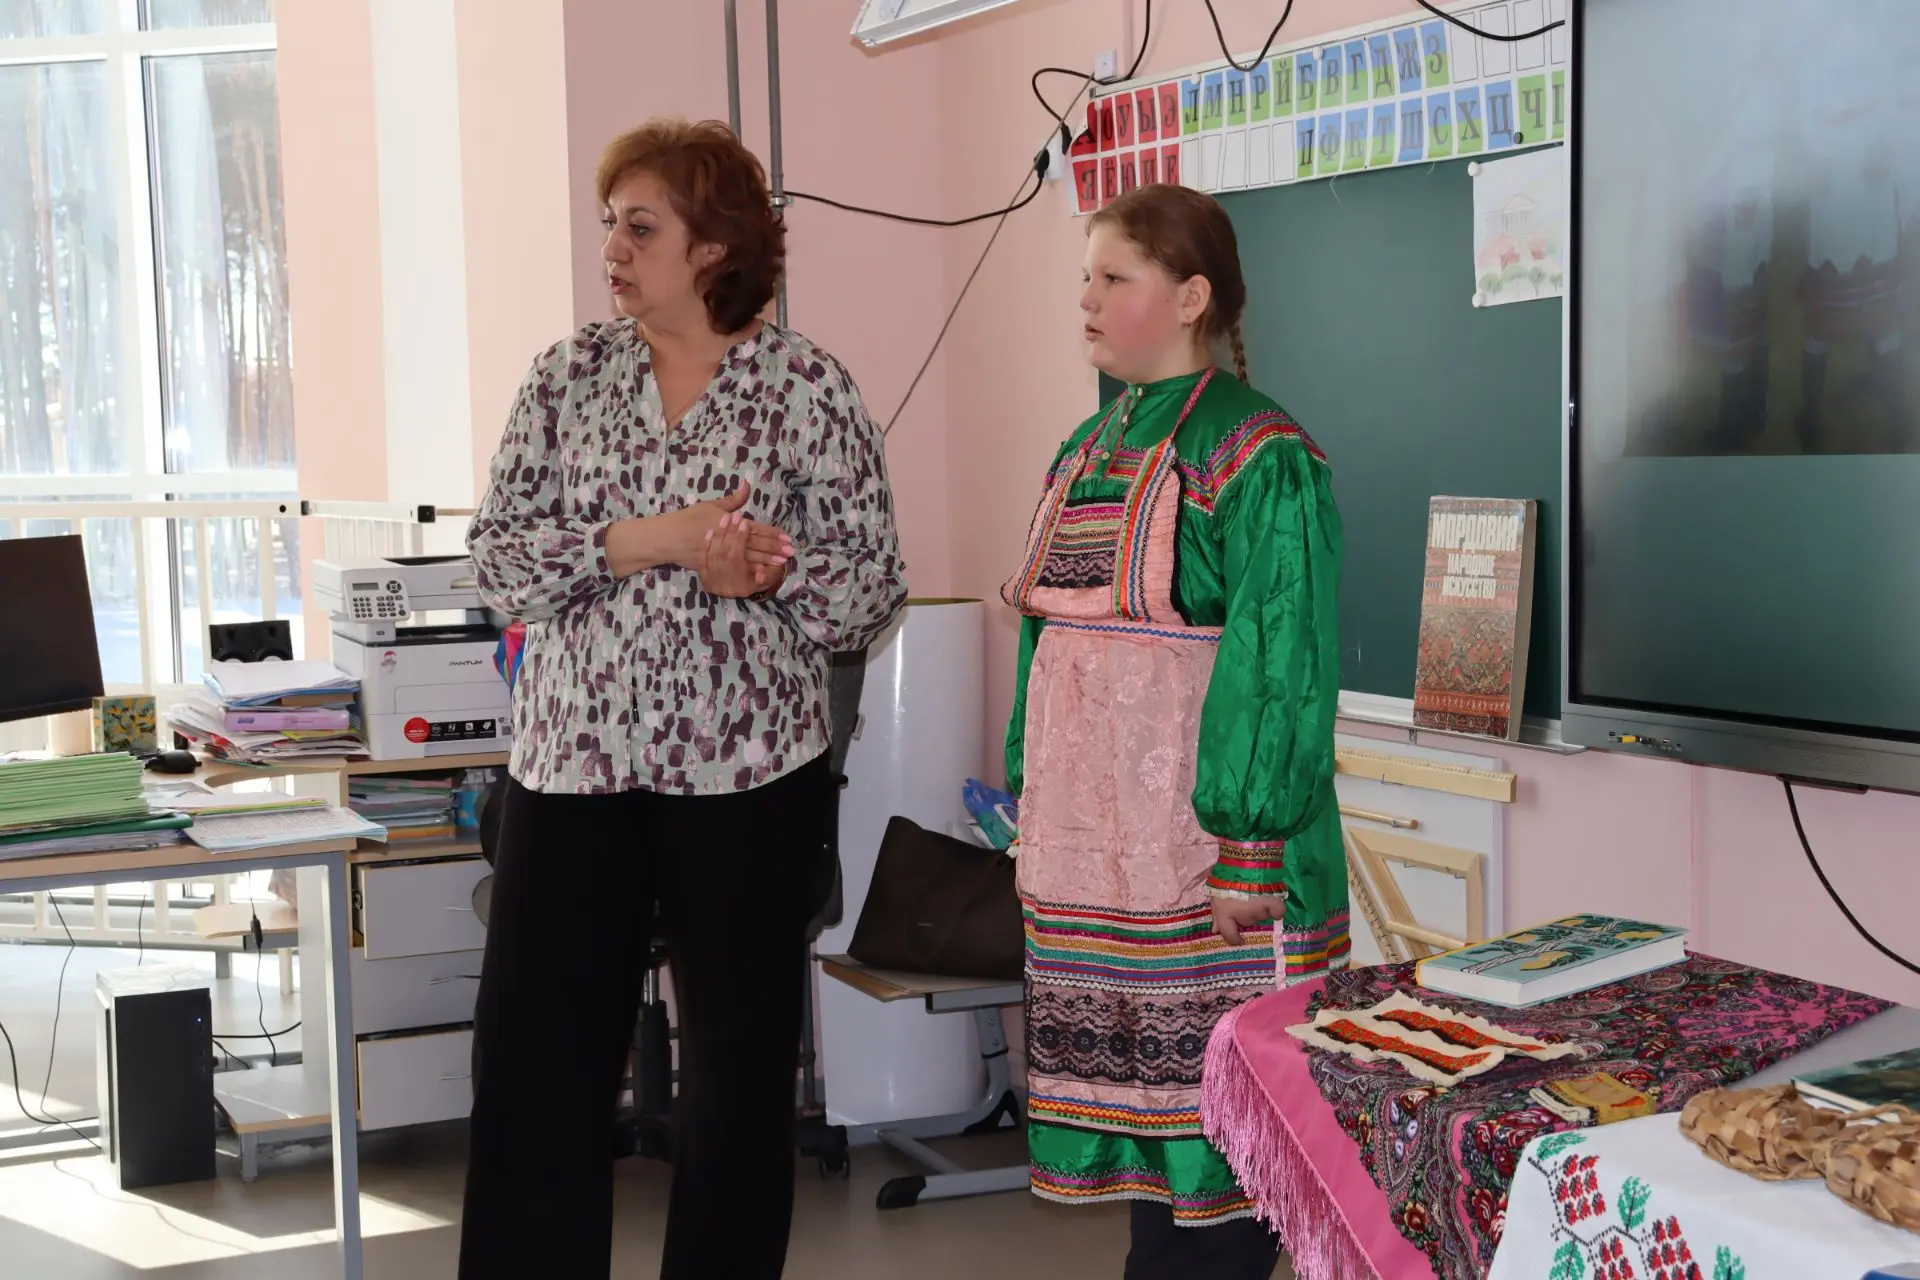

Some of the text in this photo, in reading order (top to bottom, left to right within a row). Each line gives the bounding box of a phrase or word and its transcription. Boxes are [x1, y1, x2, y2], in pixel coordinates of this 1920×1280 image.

[1119, 104, 1130, 137] У
[1138, 97, 1157, 132] Ы
[1164, 94, 1176, 128] Э
[1185, 88, 1198, 124] Л
[1203, 83, 1223, 119] М
[1230, 79, 1246, 115] Н
[1253, 75, 1267, 110] Р
[1275, 61, 1292, 106] Й
[1299, 64, 1314, 101] Б
[1325, 59, 1340, 96] В
[1373, 46, 1395, 100] Д
[1396, 40, 1421, 81] Ж
[1082, 169, 1097, 201] Я
[1320, 123, 1340, 160] Ф
[1433, 105, 1449, 145] С
[1458, 101, 1481, 141] Х
[1489, 93, 1514, 144] Ц
[1522, 88, 1543, 128] Ч
[1432, 513, 1518, 553] МОРДОВИЯ
